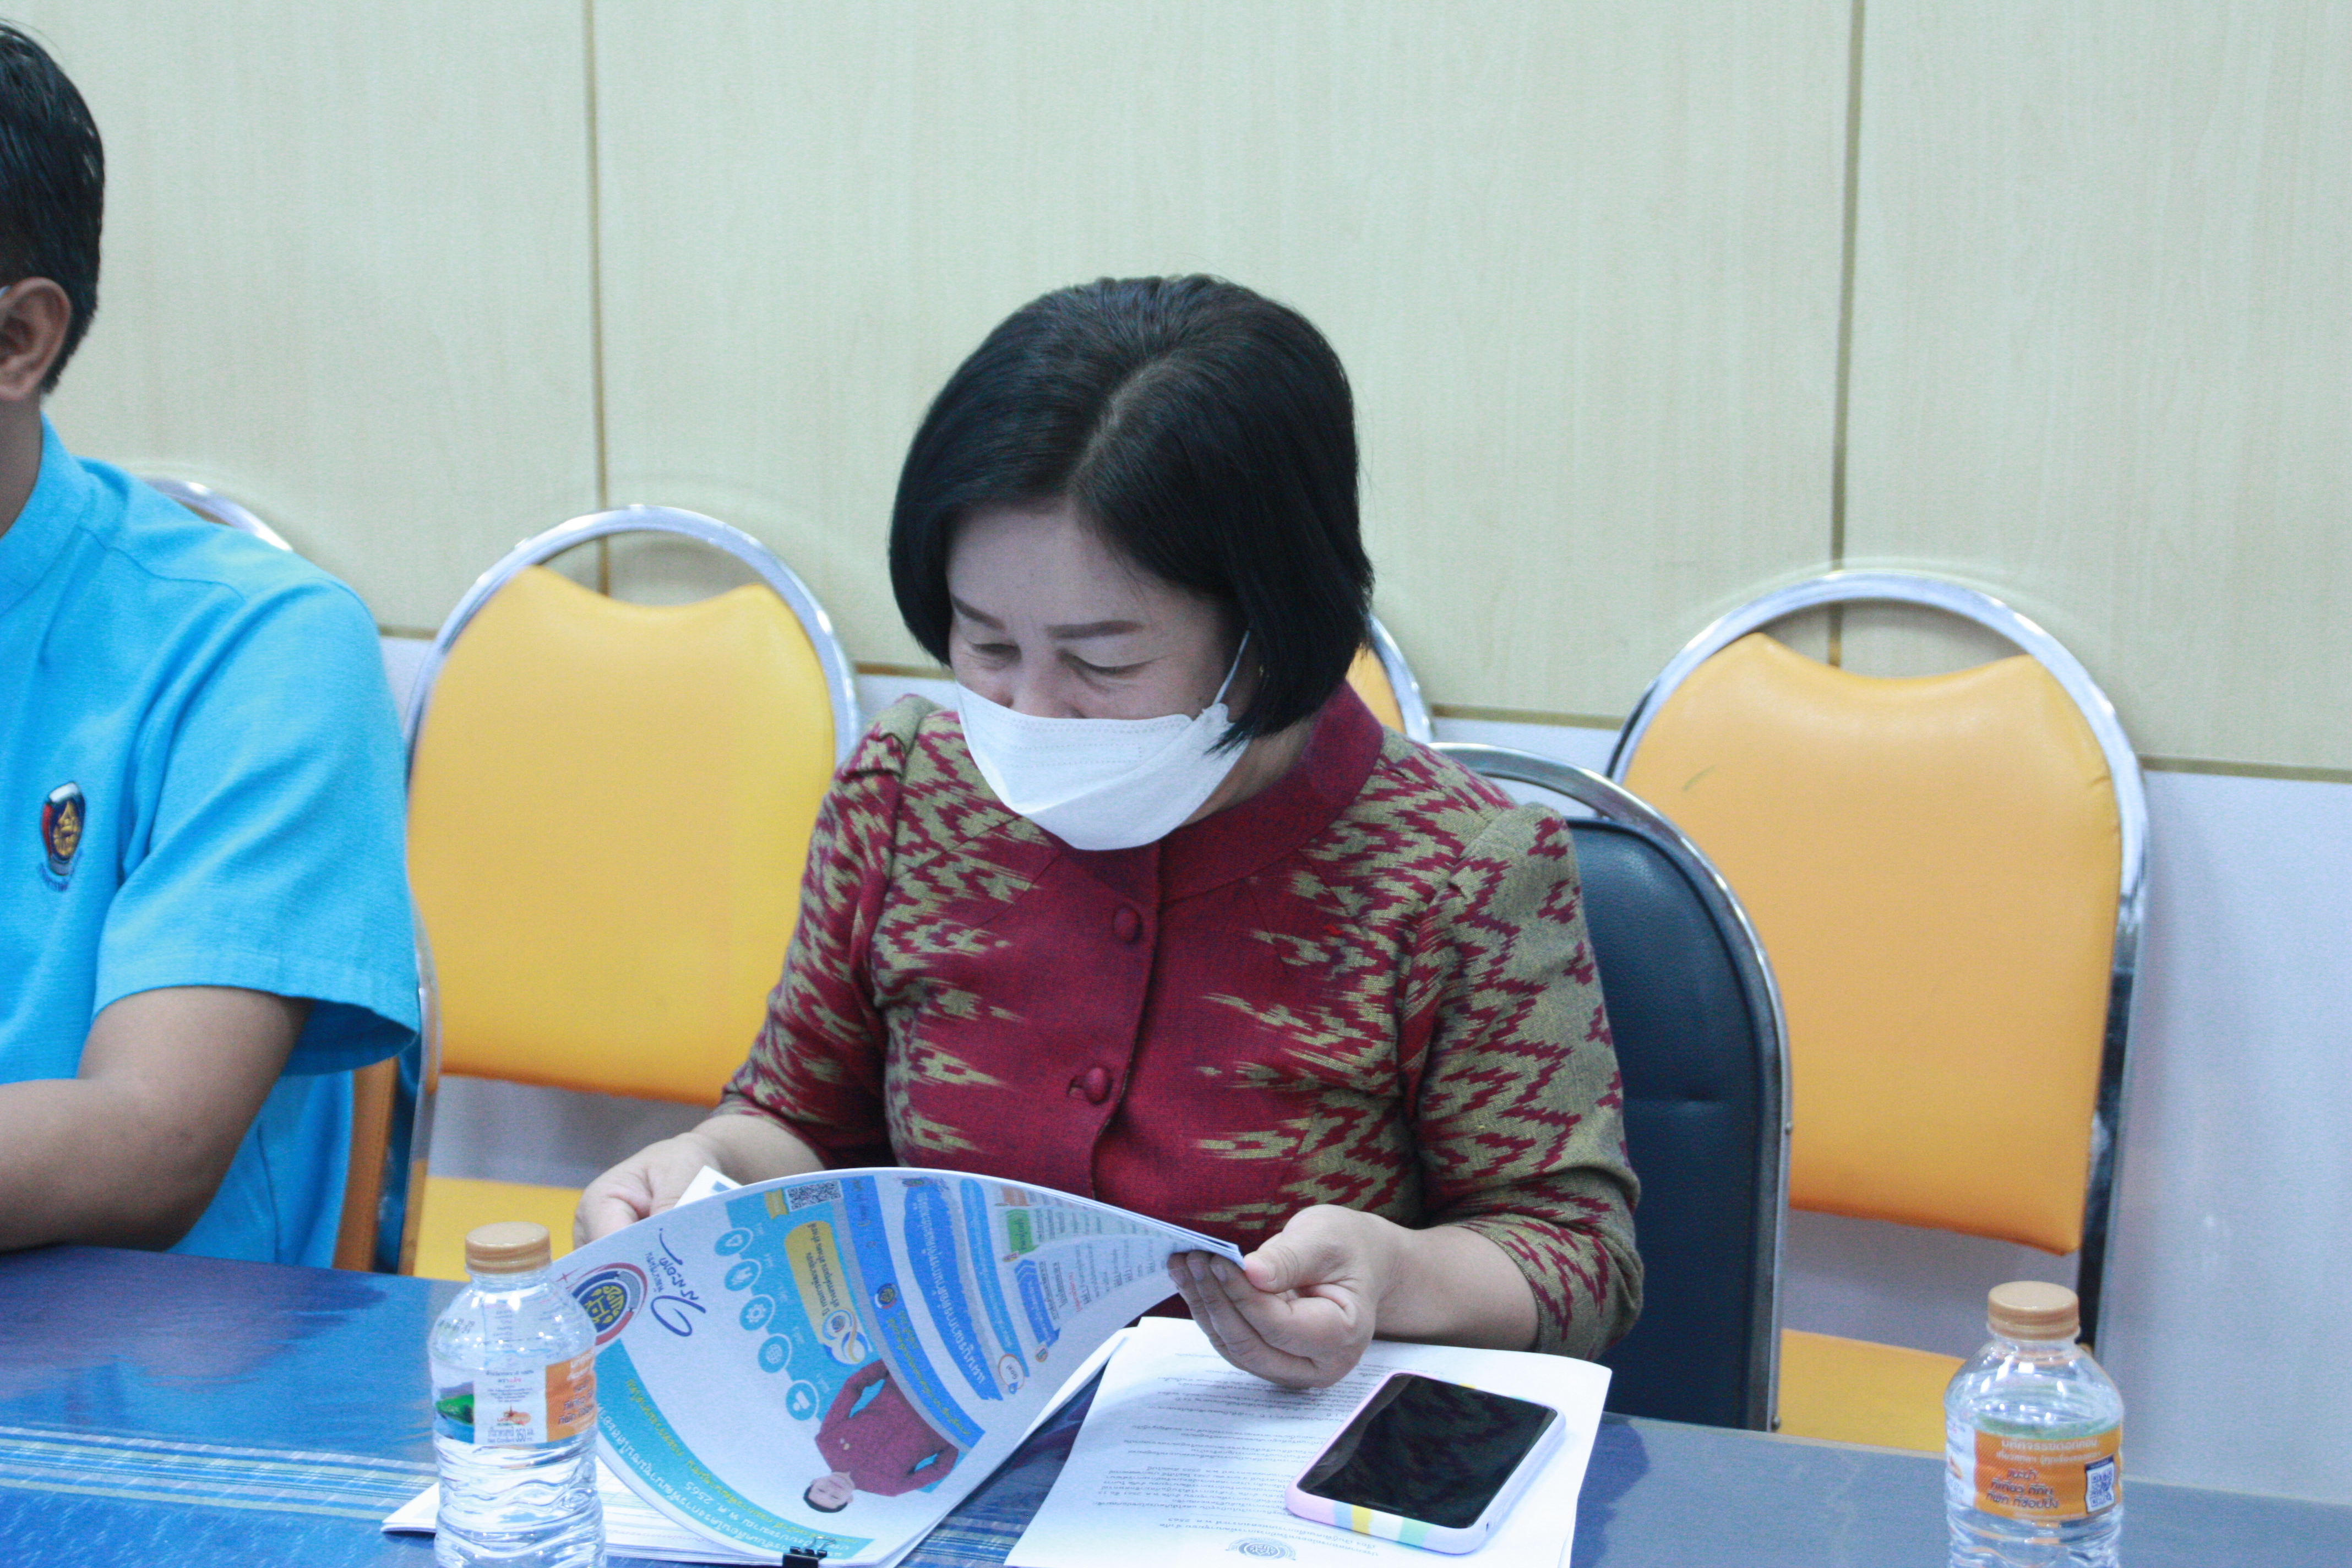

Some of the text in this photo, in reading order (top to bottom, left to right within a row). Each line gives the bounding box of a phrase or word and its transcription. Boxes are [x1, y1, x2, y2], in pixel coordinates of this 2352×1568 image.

[644, 1251, 665, 1293] พัฒนาชุมชน
[1004, 1363, 1020, 1380] Goal
[515, 1429, 526, 1442] 350
[2008, 1467, 2038, 1479] แนะนำ
[683, 1479, 714, 1506] 2565
[1991, 1475, 2054, 1495] ที่เที่ยว ที่กิน
[1986, 1490, 2059, 1508] ที่พัก ที่ช้อปปิ้ง
[714, 1501, 740, 1520] พ.ศ.
[1355, 1541, 1375, 1550] เรื่อง
